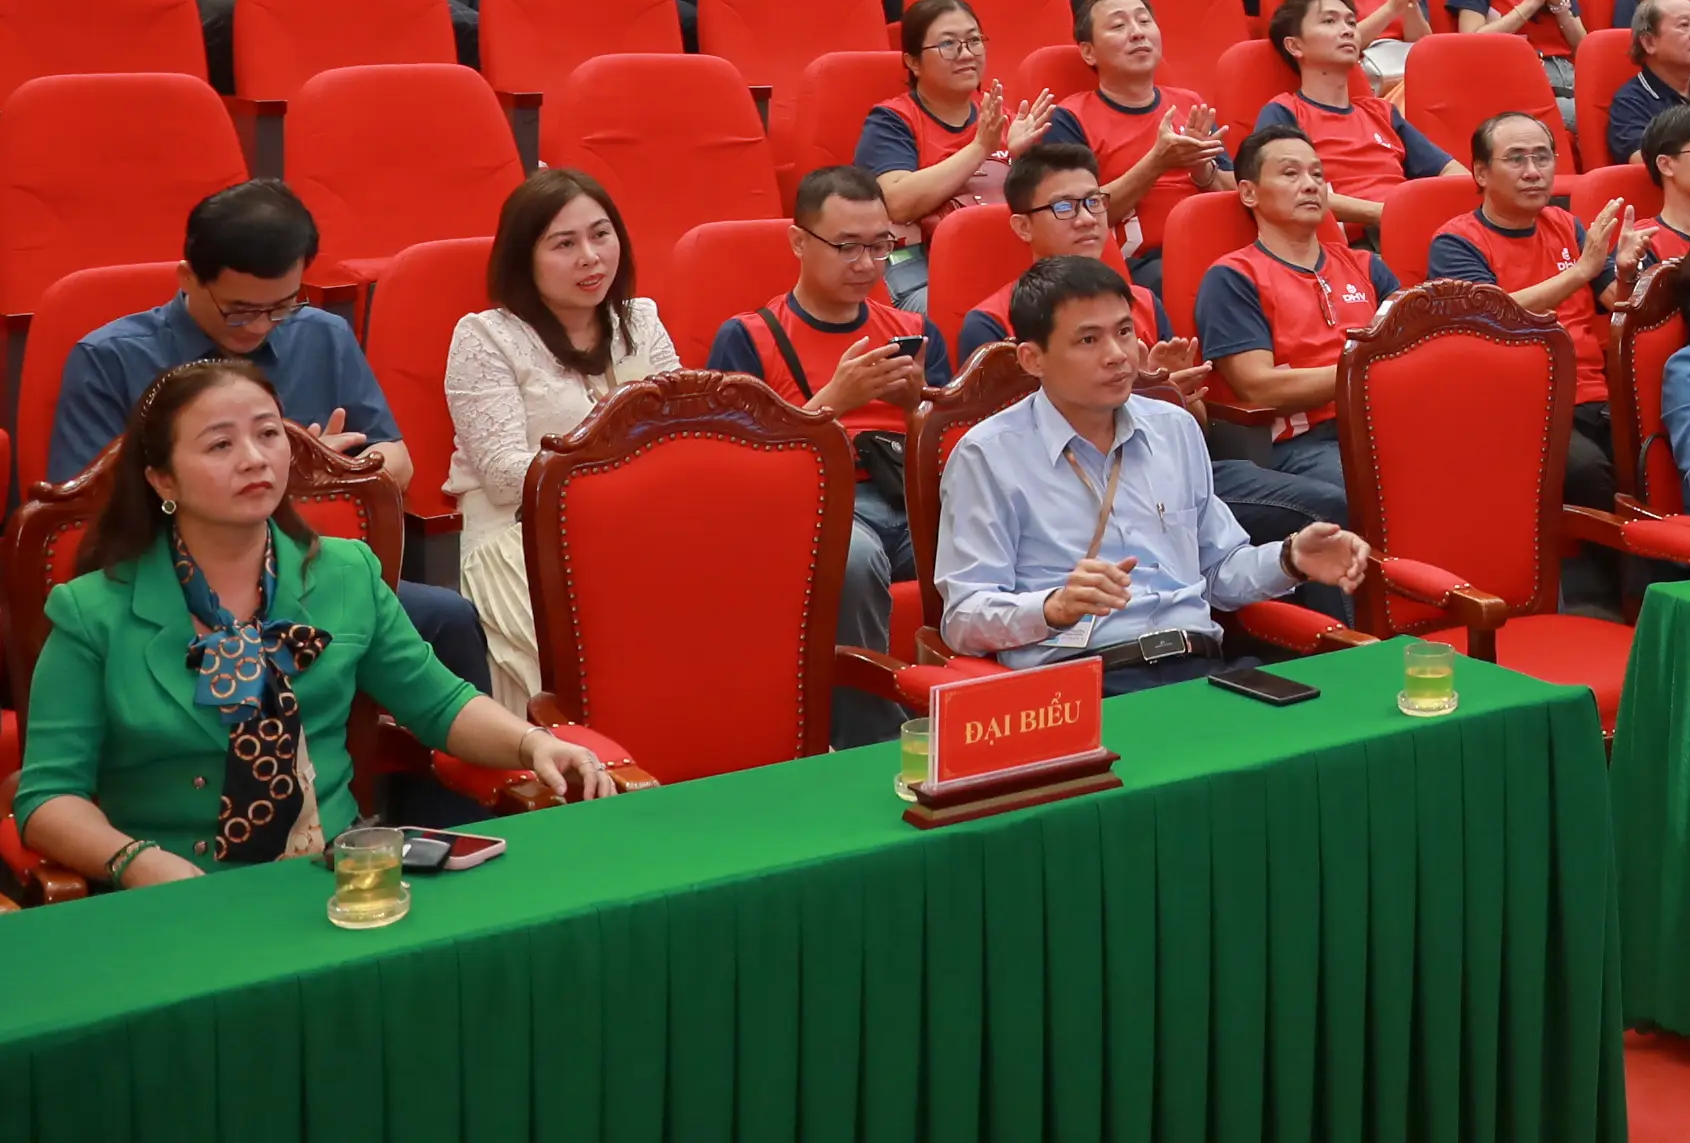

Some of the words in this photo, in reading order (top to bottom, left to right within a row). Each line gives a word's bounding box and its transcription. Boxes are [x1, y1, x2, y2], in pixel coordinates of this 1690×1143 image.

[1341, 292, 1366, 302] DHV
[964, 713, 1012, 746] ĐẠI
[1019, 691, 1082, 733] BIỂU
